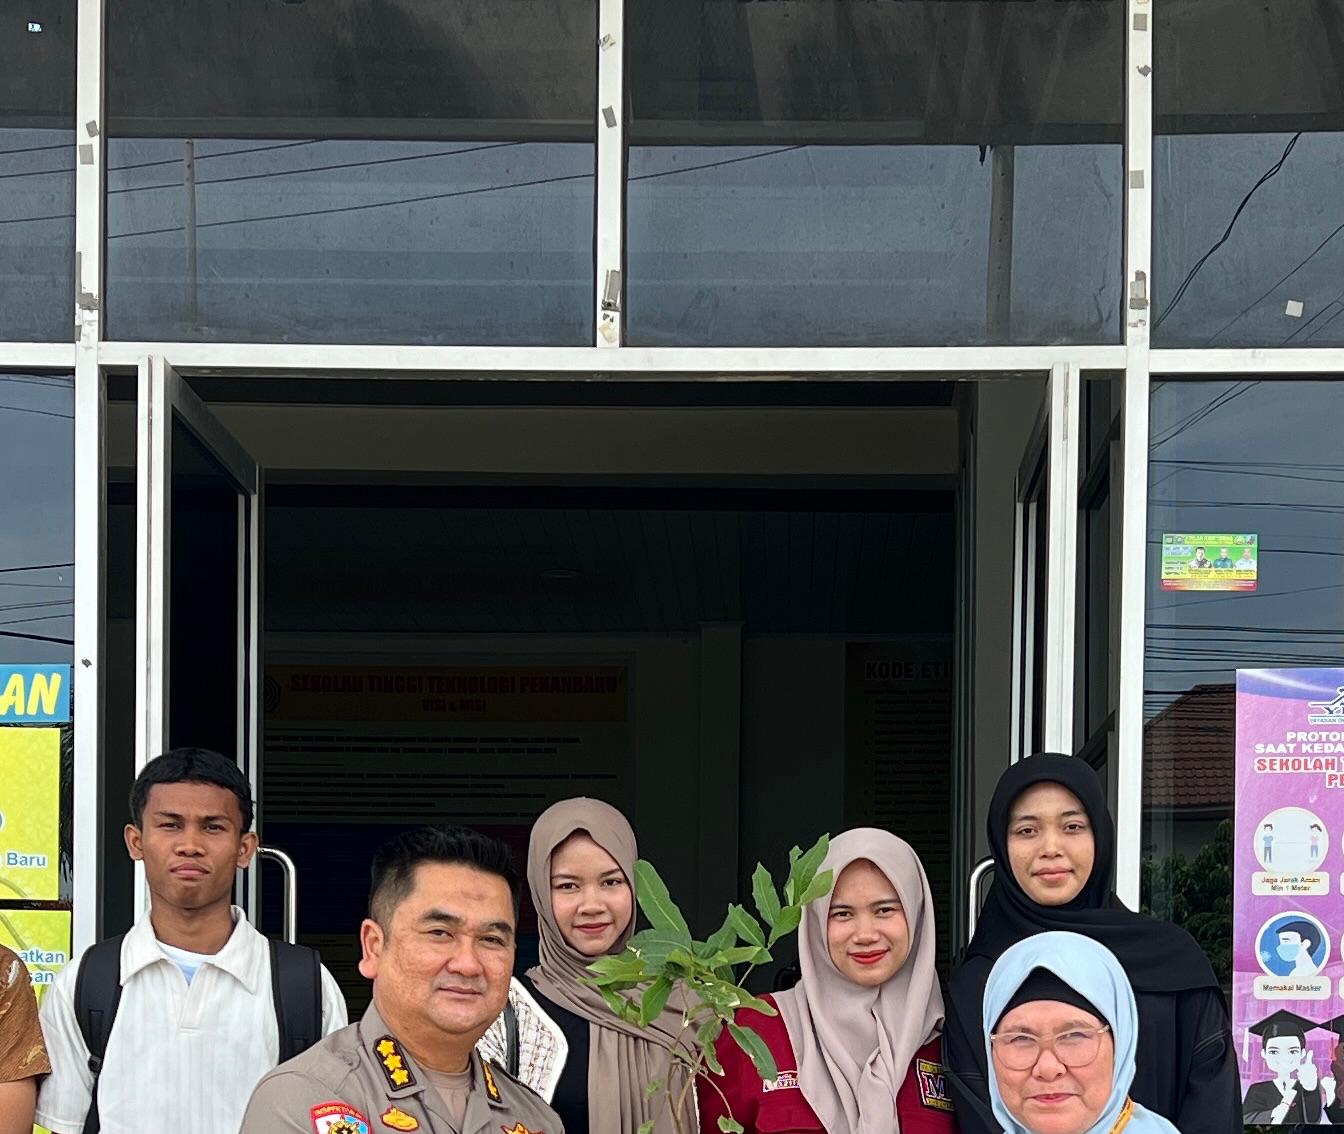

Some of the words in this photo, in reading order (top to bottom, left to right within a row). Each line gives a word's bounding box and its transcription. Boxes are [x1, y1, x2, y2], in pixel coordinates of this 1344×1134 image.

[1254, 743, 1297, 754] SAAT
[1256, 758, 1336, 771] SEKOLAH
[6, 852, 46, 866] Baru
